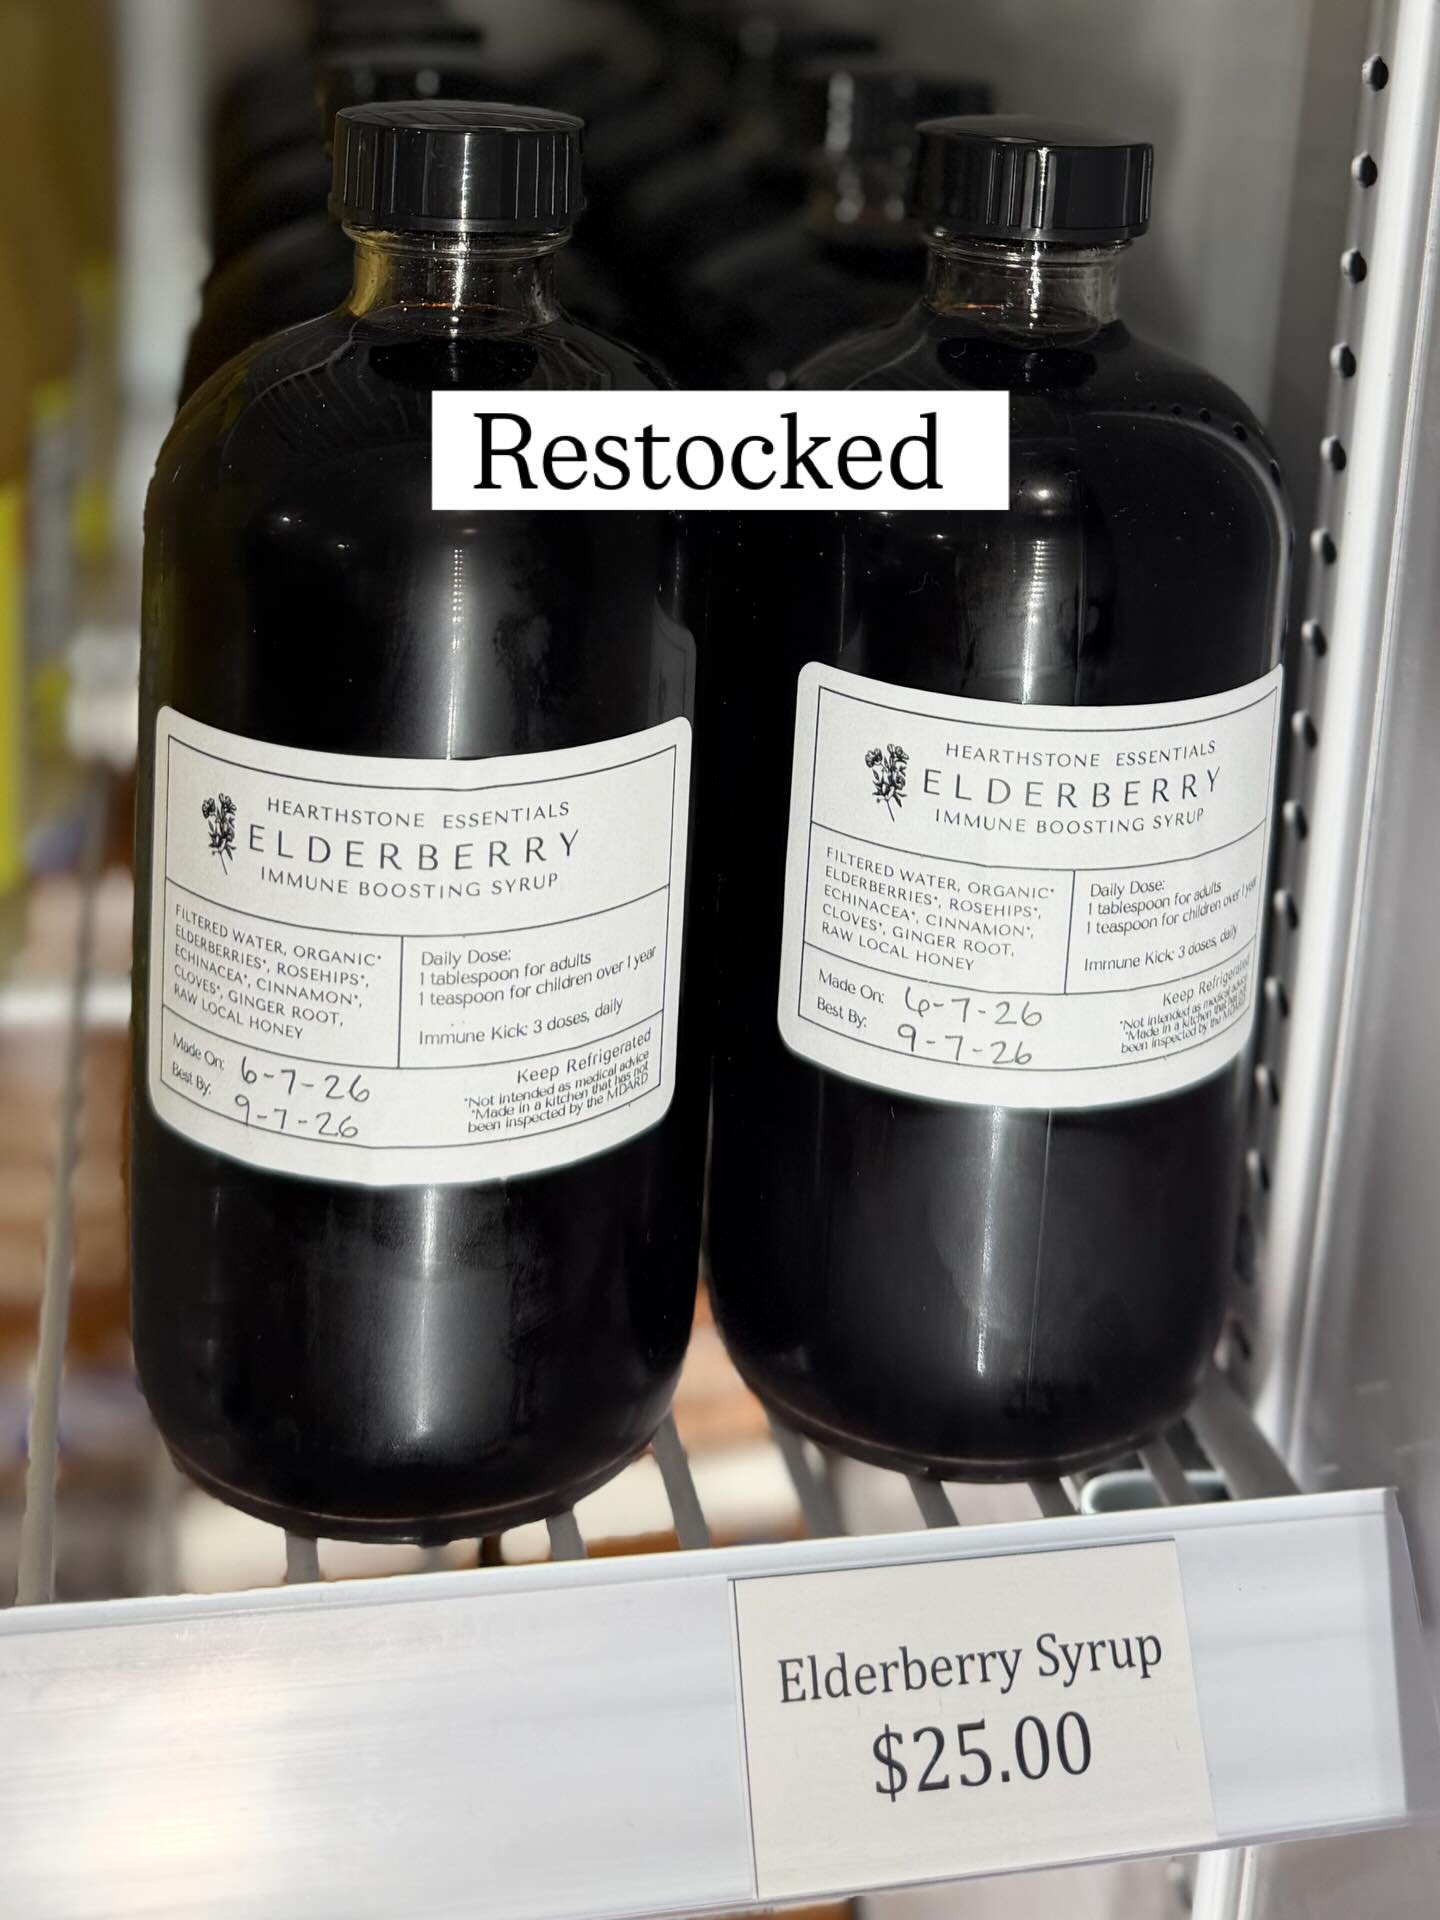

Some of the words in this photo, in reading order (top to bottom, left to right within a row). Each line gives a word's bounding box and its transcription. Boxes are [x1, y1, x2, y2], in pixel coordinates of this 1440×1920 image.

[946, 742, 1100, 768] HEARTHSTONE
[1115, 739, 1216, 767] ESSENTIALS
[923, 766, 1221, 808] ELDERBERRY
[267, 797, 425, 828] HEARTHSTONE
[443, 801, 569, 829] ESSENTIALS
[936, 808, 1026, 832] IMMUNE
[1037, 817, 1145, 835] BOOSTING
[1152, 807, 1204, 830] SYRUP
[249, 823, 579, 871] ELDERBERRY
[261, 866, 348, 895] IMMUNE
[359, 881, 481, 899] BOOSTING
[491, 872, 558, 895] SYRUP
[826, 846, 894, 877] FILTERED
[900, 868, 961, 893] WATER,
[1090, 883, 1125, 900] Daily
[1130, 879, 1166, 894] Dose:
[1096, 915, 1158, 936] teaspoon
[1161, 912, 1179, 926] for
[1182, 900, 1221, 923] children
[1223, 888, 1240, 907] over
[1098, 896, 1170, 918] tablespoon
[1174, 892, 1191, 906] for
[1193, 881, 1222, 901] adults
[175, 903, 228, 938] FILTERED
[232, 930, 287, 957] WATER,
[822, 921, 854, 943] RAW
[859, 934, 909, 959] LOCAL
[915, 949, 975, 971] HONEY
[892, 926, 956, 950] GINGER
[963, 939, 1015, 957] ROOT,
[421, 951, 461, 969] Daily
[468, 948, 512, 964] Dose:
[430, 988, 504, 1008] teaspoon
[509, 982, 532, 999] for
[535, 970, 592, 995] children
[596, 960, 623, 980] over
[634, 945, 657, 970] year
[431, 966, 519, 987] tablespoon
[524, 960, 545, 977] for
[550, 951, 592, 973] adults
[1084, 957, 1141, 972] Immune
[1145, 948, 1175, 966] Kick:
[1178, 945, 1185, 959] 3
[818, 968, 856, 994] Made
[860, 984, 885, 1004] On:
[904, 986, 1043, 1027] 6-7-26
[1162, 988, 1194, 1007] Keep
[174, 983, 198, 1006] RAW
[201, 998, 244, 1025] LOCAL
[250, 1015, 303, 1039] HONEY
[228, 990, 285, 1017] GINGER
[291, 1006, 344, 1027] ROOT,
[419, 1029, 485, 1045] Immune
[491, 1023, 528, 1041] Kick:
[533, 1019, 542, 1033] 3
[547, 1010, 590, 1031] doses,
[594, 996, 624, 1018] daily
[817, 996, 844, 1019] Best
[848, 1010, 867, 1029] By:
[172, 1032, 202, 1059] Made
[516, 1066, 559, 1084] Keep
[567, 1027, 651, 1075] Refrigerated
[897, 1023, 1033, 1065] 9-7-26
[1121, 1042, 1149, 1054] been
[1151, 1026, 1197, 1049] inspected
[172, 1061, 192, 1085] Best
[241, 1055, 370, 1103] 6-7-26
[499, 1084, 555, 1104] intended
[559, 1079, 571, 1091] as
[575, 1064, 617, 1089] medical
[619, 1049, 649, 1073] advice
[519, 1100, 530, 1114] in
[534, 1099, 541, 1110] a
[545, 1087, 588, 1109] kitchen
[591, 1081, 612, 1095] that
[614, 1070, 631, 1089] has
[634, 1061, 648, 1077] not
[235, 1093, 359, 1138] 9-7-26
[467, 1117, 501, 1134] been
[505, 1103, 566, 1129] inspected
[569, 1101, 583, 1117] by
[587, 1092, 604, 1109] the
[606, 1072, 649, 1102] MDARD
[777, 1645, 1023, 1704] Elderberry
[1035, 1632, 1163, 1688] Syrup
[872, 1710, 1092, 1803] $25.00
